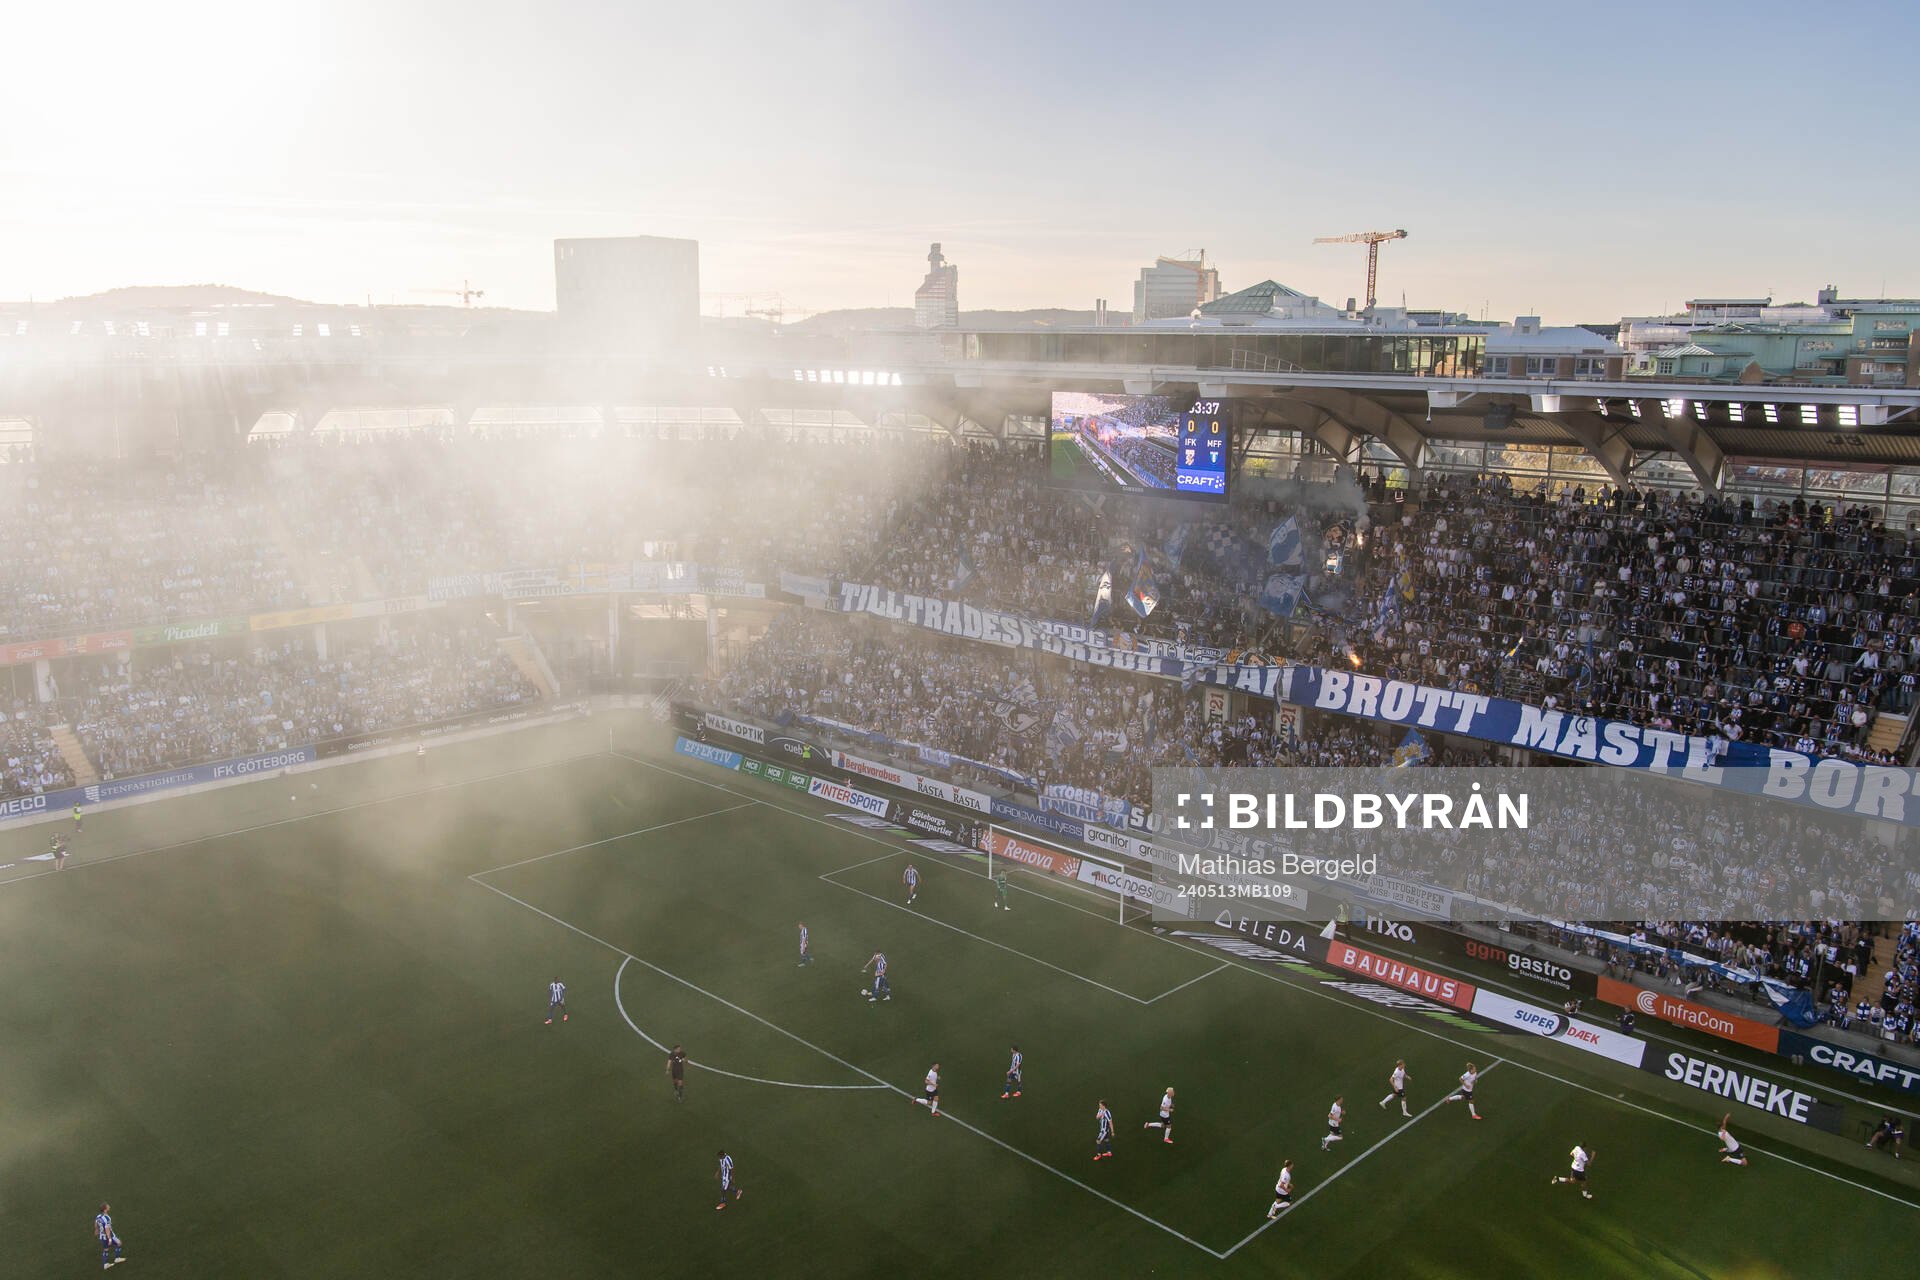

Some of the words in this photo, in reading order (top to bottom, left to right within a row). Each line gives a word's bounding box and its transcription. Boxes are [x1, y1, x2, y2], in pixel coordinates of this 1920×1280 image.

[1187, 420, 1195, 433] 0
[1211, 421, 1219, 434] 0
[1184, 438, 1197, 447] IFK
[1207, 439, 1223, 449] MFF
[1177, 475, 1216, 487] CRAFT
[165, 622, 219, 640] Picadeli
[707, 716, 734, 732] WASA
[735, 724, 763, 742] OPTIK
[684, 740, 733, 764] EFFEKTIV
[1314, 668, 1490, 734] BROTT
[1511, 704, 1729, 785] MÅSTE
[1763, 748, 1920, 822] BOR
[213, 763, 235, 779] IFK
[236, 751, 306, 775] GÖTEBORG
[845, 757, 902, 785] Bergkvarabuss
[100, 772, 195, 797] STENFASTIGHETER
[917, 783, 944, 799] RASTA
[821, 783, 884, 814] INTERSPORT
[953, 792, 982, 810] RASTA
[907, 816, 953, 838] Metallpartier
[911, 808, 946, 827] Göteborgs
[1088, 828, 1129, 850] granitor
[1003, 839, 1054, 870] Renova
[1138, 844, 1179, 865] granito
[1238, 915, 1306, 952] ELEDA
[1343, 948, 1455, 999] BAUHAUS
[1514, 1009, 1555, 1030] SUPER
[1663, 999, 1735, 1036] InfraCom
[1810, 1045, 1920, 1089] CRAFT
[1665, 1052, 1814, 1124] SERNEKE
